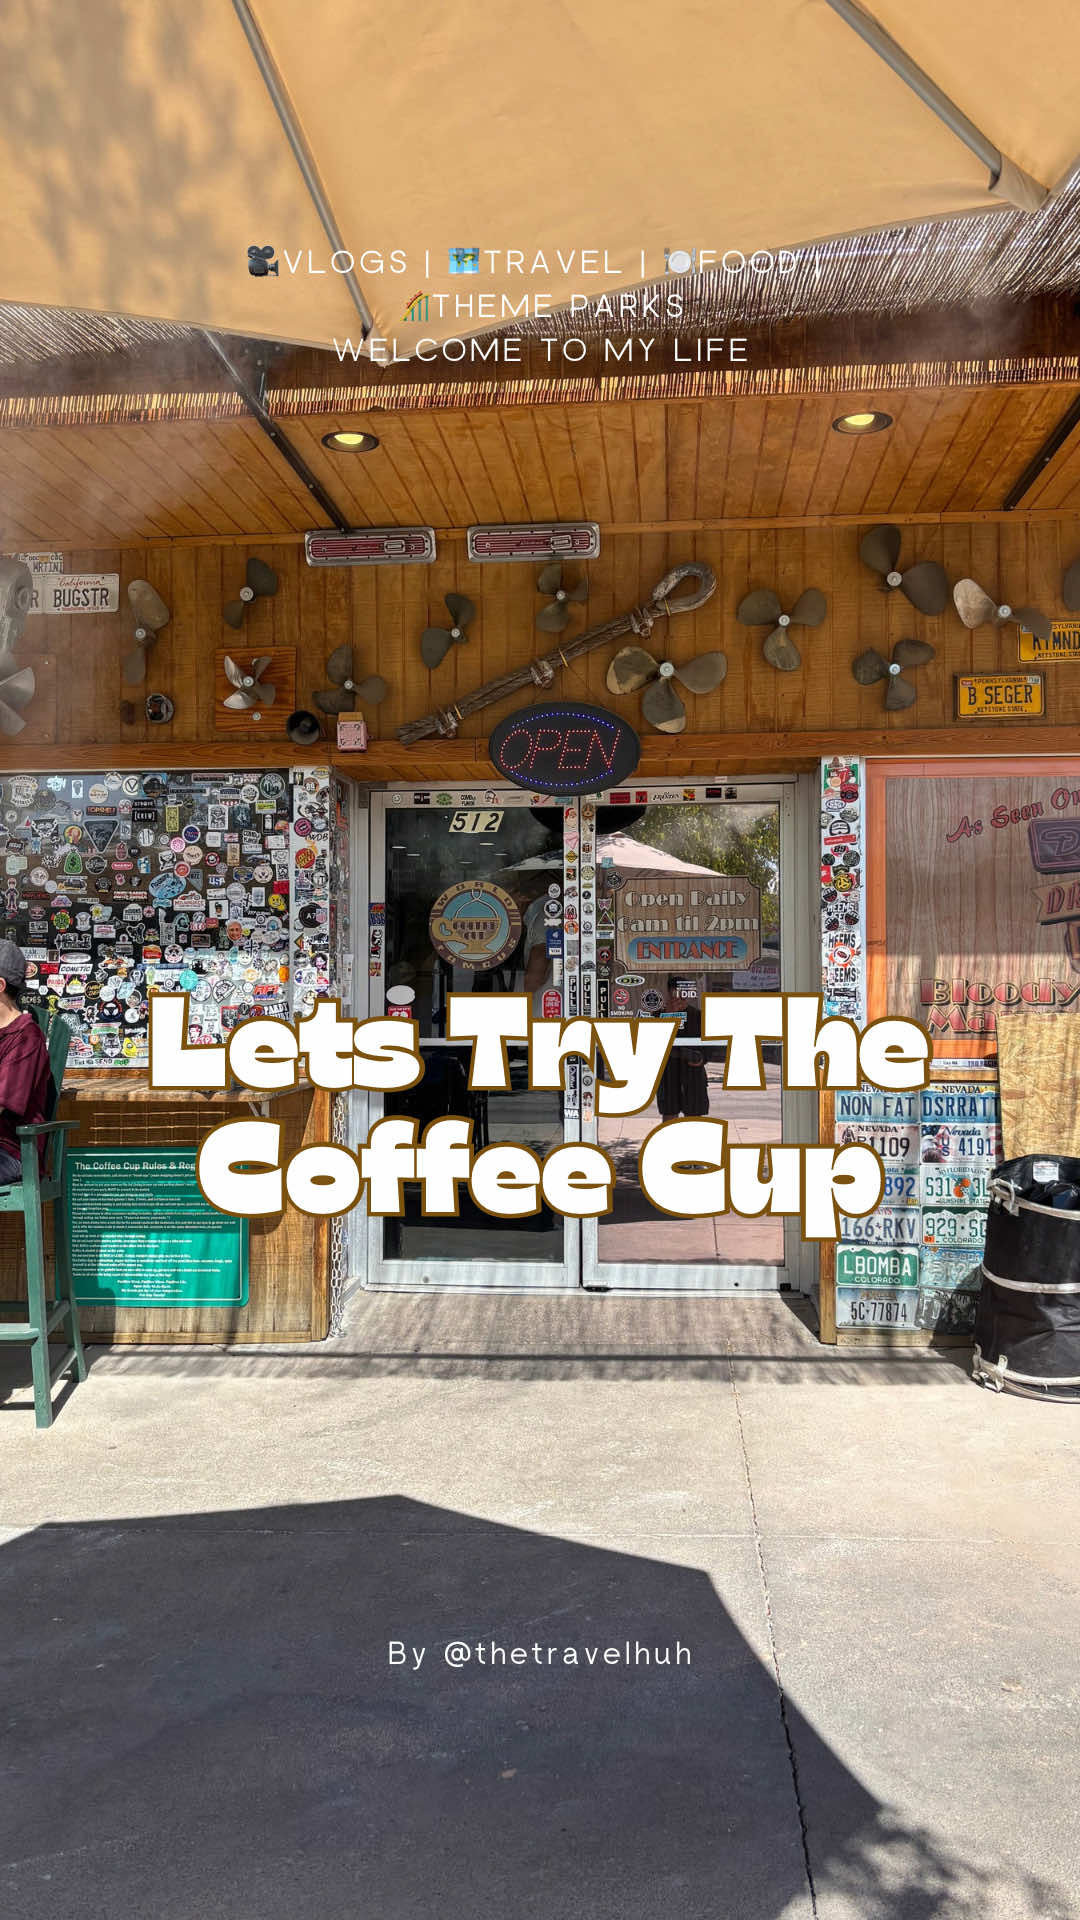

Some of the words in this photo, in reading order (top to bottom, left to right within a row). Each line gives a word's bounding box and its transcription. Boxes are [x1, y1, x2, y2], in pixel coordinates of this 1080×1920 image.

[53, 588, 109, 608] BUGSTR
[967, 686, 977, 706] B
[984, 684, 1033, 705] SEGER
[499, 728, 621, 770] OPEN
[452, 812, 501, 832] 512
[946, 815, 983, 843] As
[990, 799, 1044, 829] Seen
[436, 881, 513, 907] WORLD
[624, 889, 686, 908] Open
[689, 888, 748, 907] Daily
[675, 913, 699, 932] til
[703, 914, 760, 933] 2pm
[636, 940, 739, 960] ENTRANCE
[569, 978, 577, 1007] PULL
[584, 977, 592, 1006] PULL
[919, 977, 1080, 1007] Bloody
[941, 1085, 982, 1094] NEVADA
[840, 1095, 873, 1116] NON
[883, 1096, 915, 1117] FAT
[857, 1125, 899, 1133] NEVADA
[941, 1124, 982, 1137] Nevada
[957, 1137, 994, 1157] 4191
[75, 1161, 91, 1170] The
[92, 1161, 125, 1170] Coffee
[127, 1161, 141, 1172] Cup
[142, 1161, 168, 1170] Rules
[169, 1161, 177, 1170] &
[884, 1176, 916, 1198] 892
[925, 1176, 952, 1198] S31
[842, 1217, 875, 1238] 166
[882, 1217, 917, 1240] RKV
[925, 1217, 957, 1238] 929
[843, 1255, 912, 1277] LBOMBA
[854, 1276, 901, 1285] COLORADO
[850, 1301, 866, 1321] 5C
[870, 1301, 908, 1322] 77874
